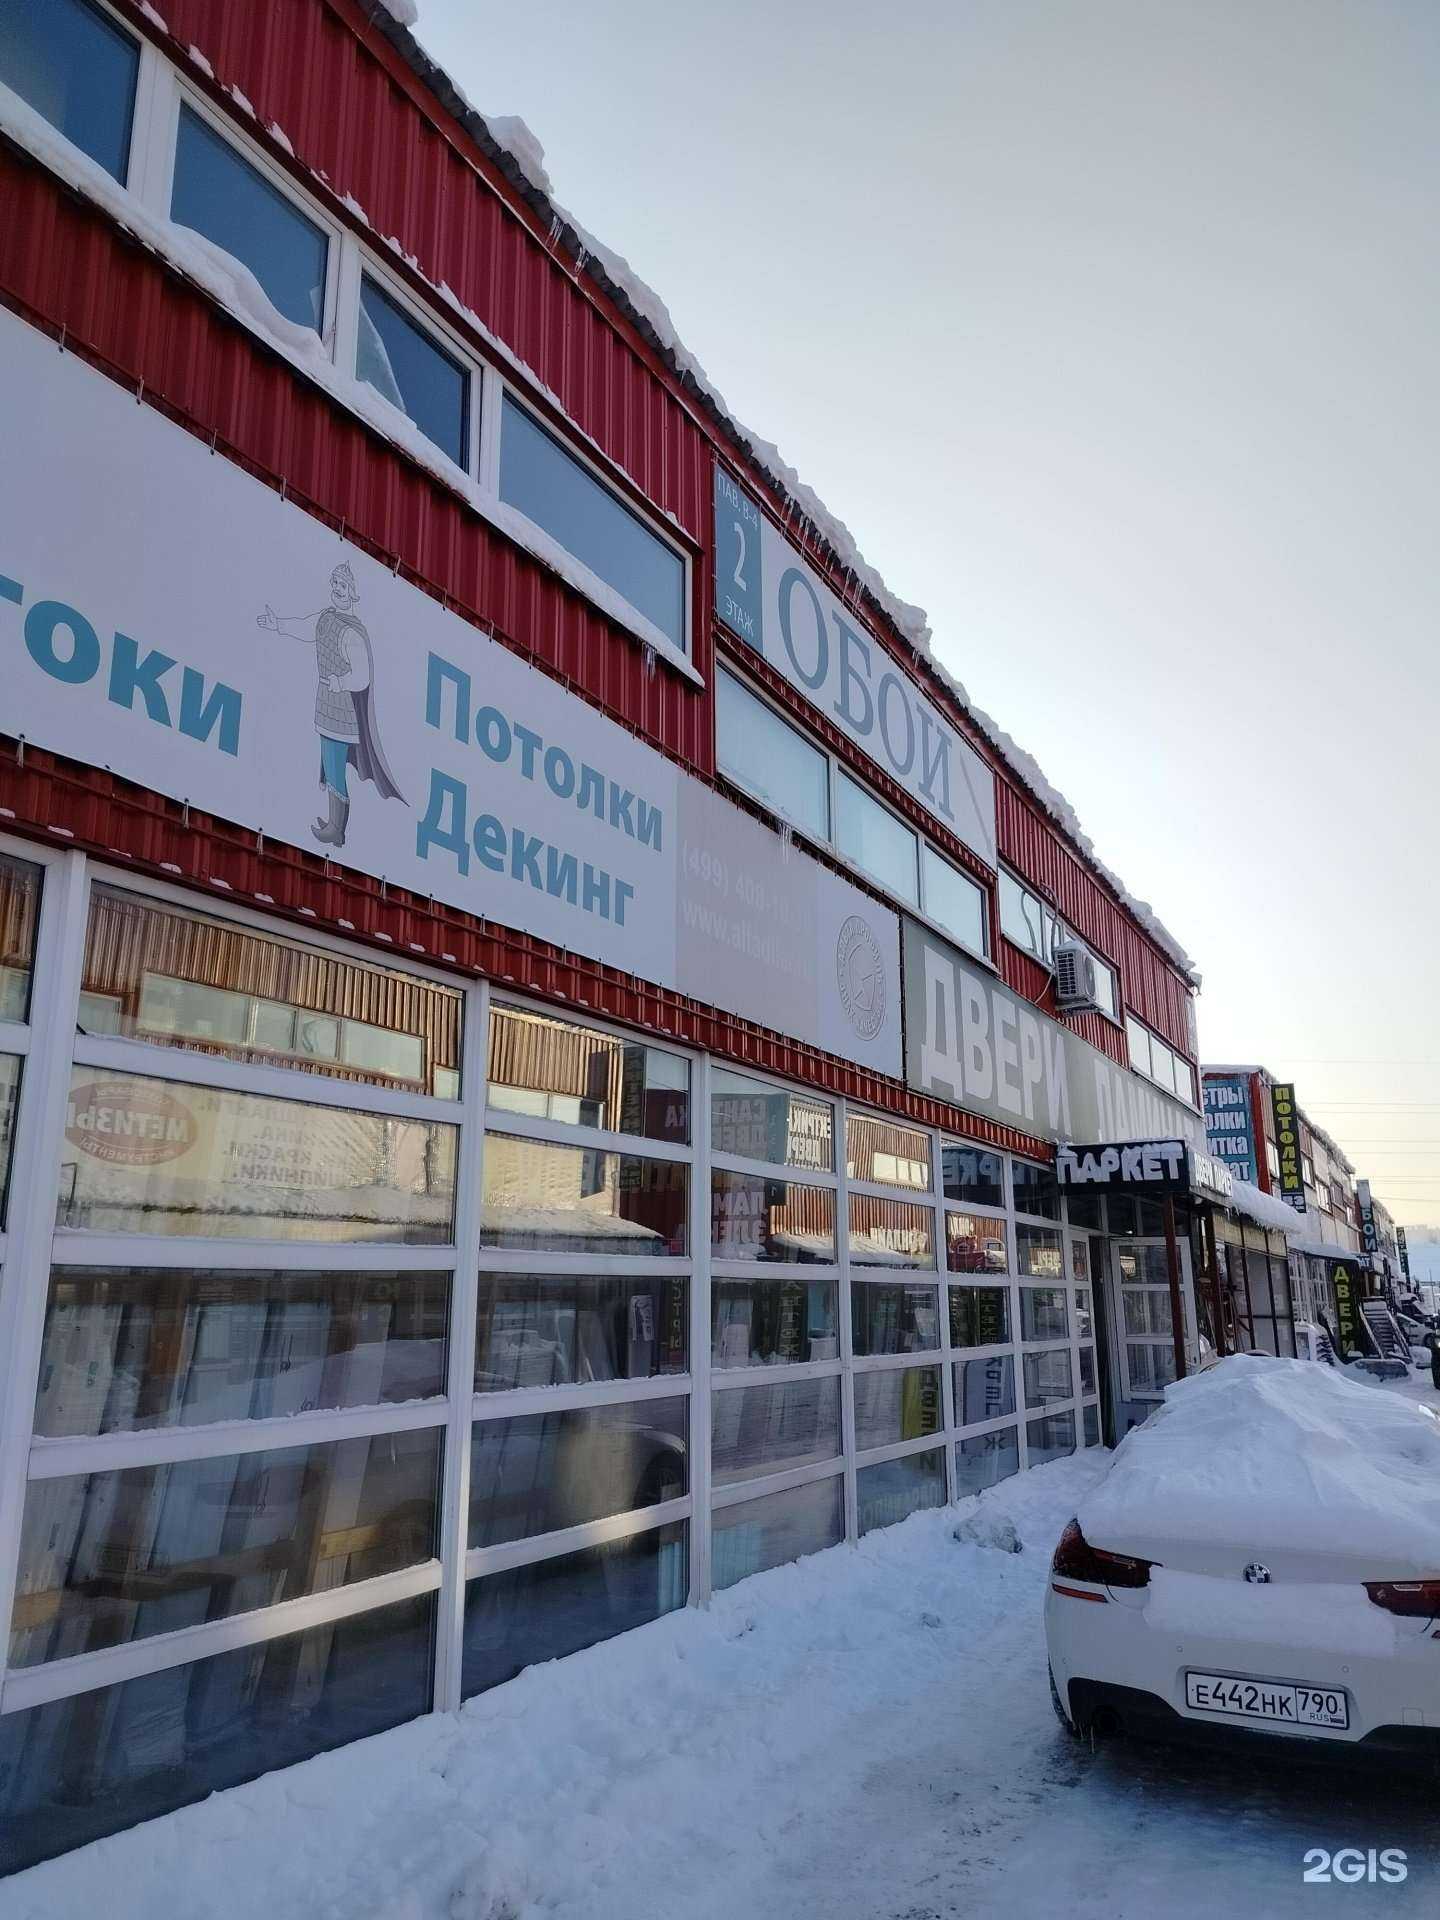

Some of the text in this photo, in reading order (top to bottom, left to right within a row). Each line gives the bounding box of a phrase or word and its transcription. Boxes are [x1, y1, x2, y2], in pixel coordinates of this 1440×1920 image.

[733, 521, 747, 592] 2
[725, 594, 754, 638] ЭТАЖ
[778, 566, 956, 822] ОБОИ
[425, 650, 664, 853] Потолки
[415, 767, 635, 926] Декинг
[921, 944, 1072, 1135] ДВЕРИ
[1057, 1145, 1184, 1183] ПАРКЕТ
[1275, 1087, 1300, 1190] ПОТОЛКИ
[1334, 1265, 1355, 1354] ДВЕРИ
[1195, 1681, 1338, 1717] Е442НК 790
[1309, 1712, 1330, 1722] RUS
